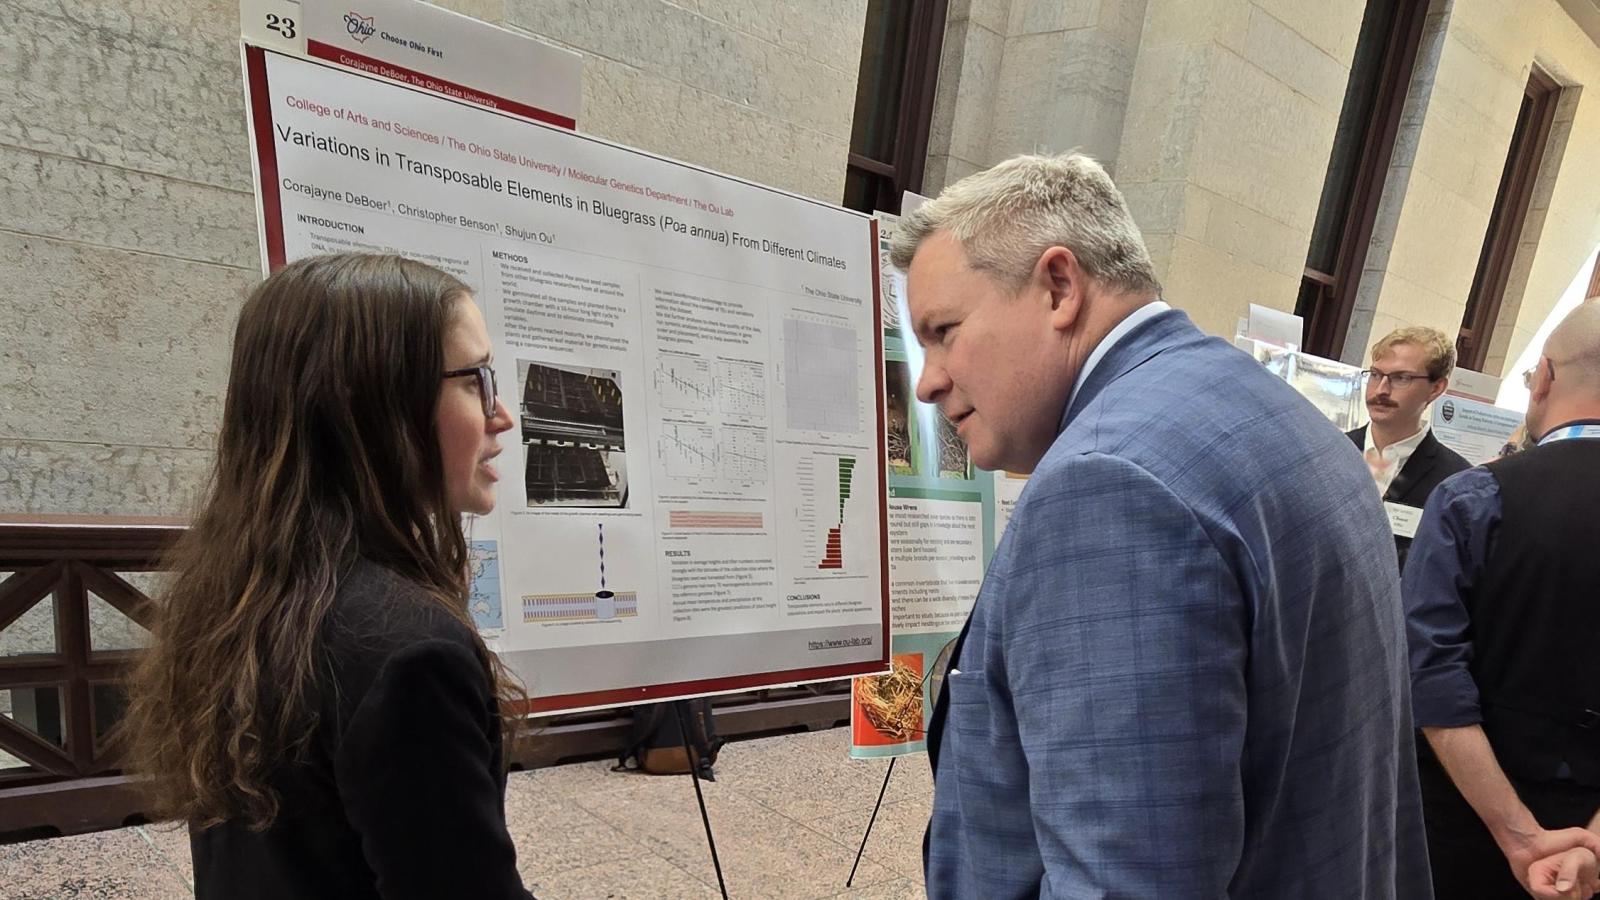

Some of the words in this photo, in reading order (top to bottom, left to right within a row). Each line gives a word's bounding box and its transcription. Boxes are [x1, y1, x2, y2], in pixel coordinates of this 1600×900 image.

[266, 13, 296, 39] 23
[344, 14, 376, 36] Ohio
[381, 31, 407, 48] Choose
[409, 39, 426, 53] Ohio
[427, 45, 443, 59] First
[340, 54, 378, 74] Corajayne
[380, 66, 410, 83] DeBoer,
[411, 75, 424, 88] The
[426, 80, 443, 92] Ohio
[444, 85, 462, 98] State
[464, 90, 497, 109] University
[286, 95, 330, 116] College
[334, 108, 344, 118] of
[347, 109, 368, 126] Arts
[372, 118, 391, 132] and
[394, 123, 440, 145] Sciences
[447, 136, 466, 151] The
[469, 142, 491, 158] Ohio
[493, 148, 517, 164] State
[519, 156, 561, 177] University
[568, 167, 608, 186] Molecular
[610, 178, 644, 195] Genetics
[645, 187, 688, 207] Department
[693, 199, 707, 211] The
[709, 202, 719, 213] Ou
[720, 206, 734, 217] Lab
[276, 122, 370, 162] Variations
[375, 147, 390, 167] in
[396, 152, 502, 194] Transposable
[507, 180, 573, 208] Elements
[577, 195, 588, 212] in
[593, 200, 656, 227] Bluegrass
[659, 214, 687, 234] (Poa
[690, 226, 729, 247] annua)
[732, 232, 760, 251] From
[762, 239, 805, 261] Different
[806, 250, 847, 270] Climates
[282, 178, 342, 202] Corajayne
[398, 203, 458, 226] Christopher
[505, 225, 536, 242] Shujun
[297, 213, 365, 235] INTRODUCTION
[492, 250, 528, 263] METHODS
